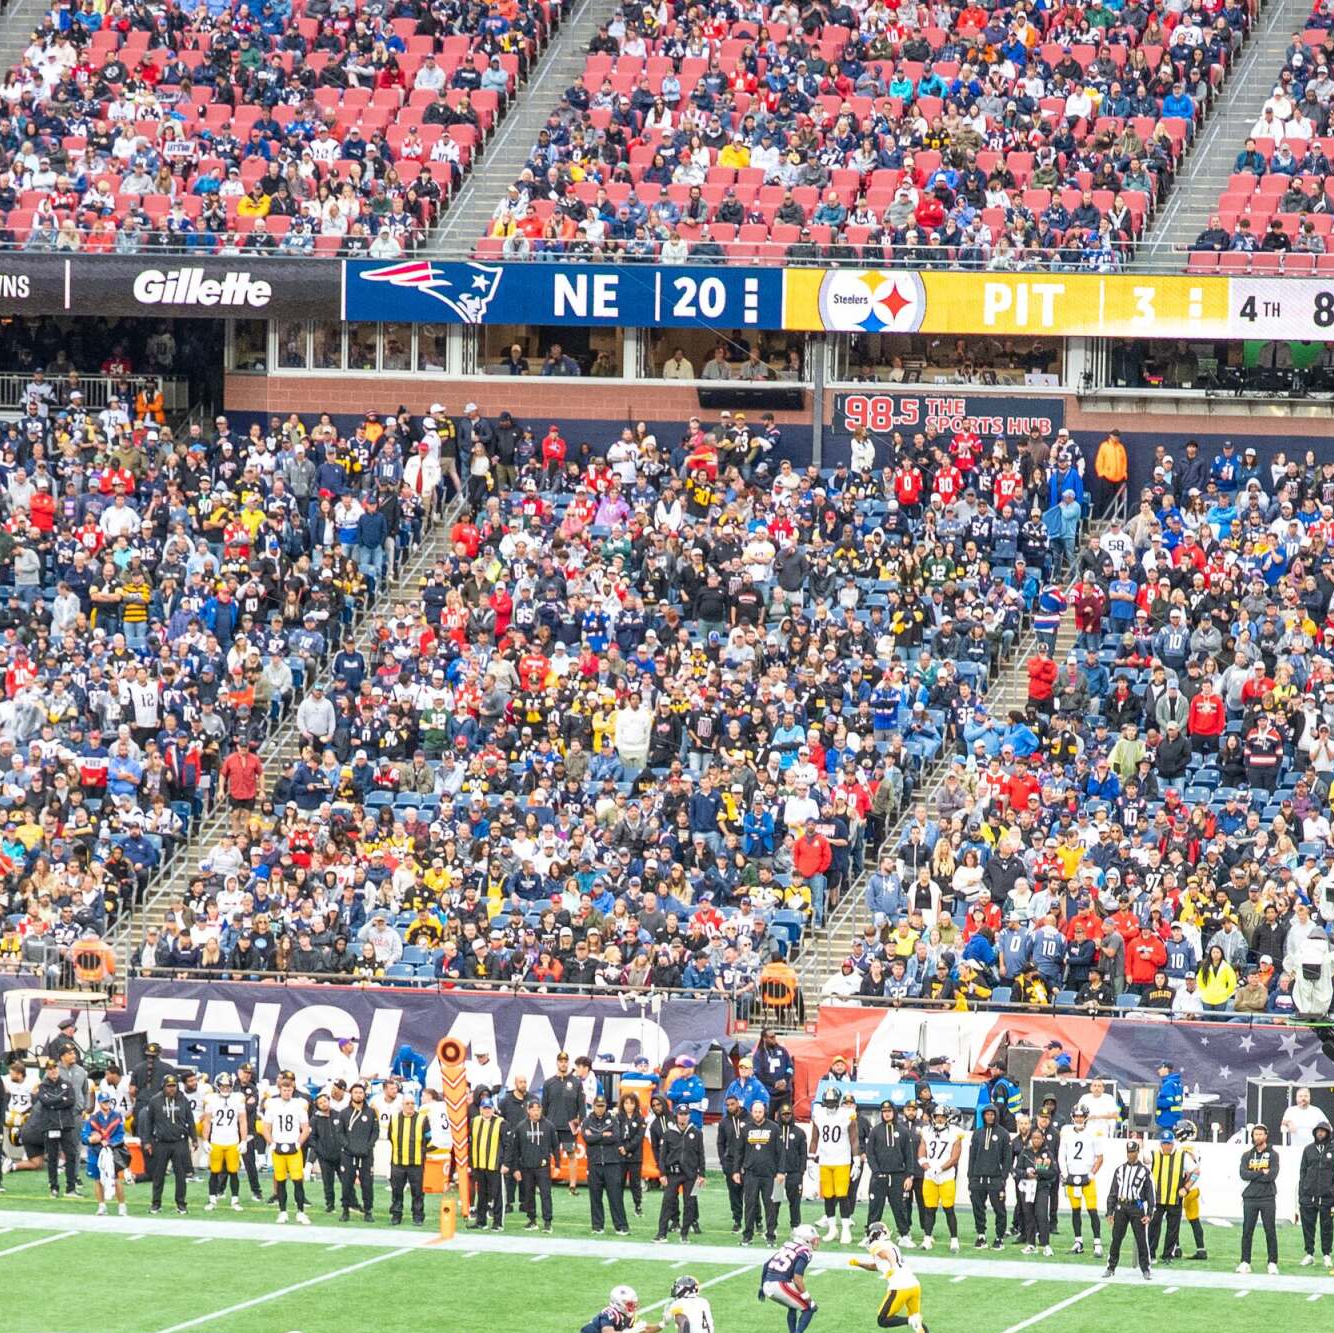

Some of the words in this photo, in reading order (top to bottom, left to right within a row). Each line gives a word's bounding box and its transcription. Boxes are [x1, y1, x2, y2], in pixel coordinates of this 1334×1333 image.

[133, 268, 272, 308] Gillette
[554, 273, 619, 318] NE
[673, 276, 725, 318] 20
[833, 292, 868, 306] Steelers
[983, 283, 1065, 327] PIT
[1134, 286, 1156, 325] 3
[845, 396, 919, 433] 98.5
[926, 399, 965, 417] THE
[925, 416, 1002, 436] SPORTS
[1006, 417, 1052, 436] HUB
[903, 476, 912, 492] 0
[938, 477, 954, 493] 80
[1000, 478, 1017, 495] 87
[1108, 539, 1125, 553] 58
[1041, 940, 1058, 956] 10
[1170, 953, 1186, 970] 10
[216, 1109, 235, 1128] 29
[278, 1114, 293, 1132] 18
[821, 1125, 841, 1144] 80
[929, 1140, 948, 1160] 37
[1073, 1141, 1082, 1160] 2
